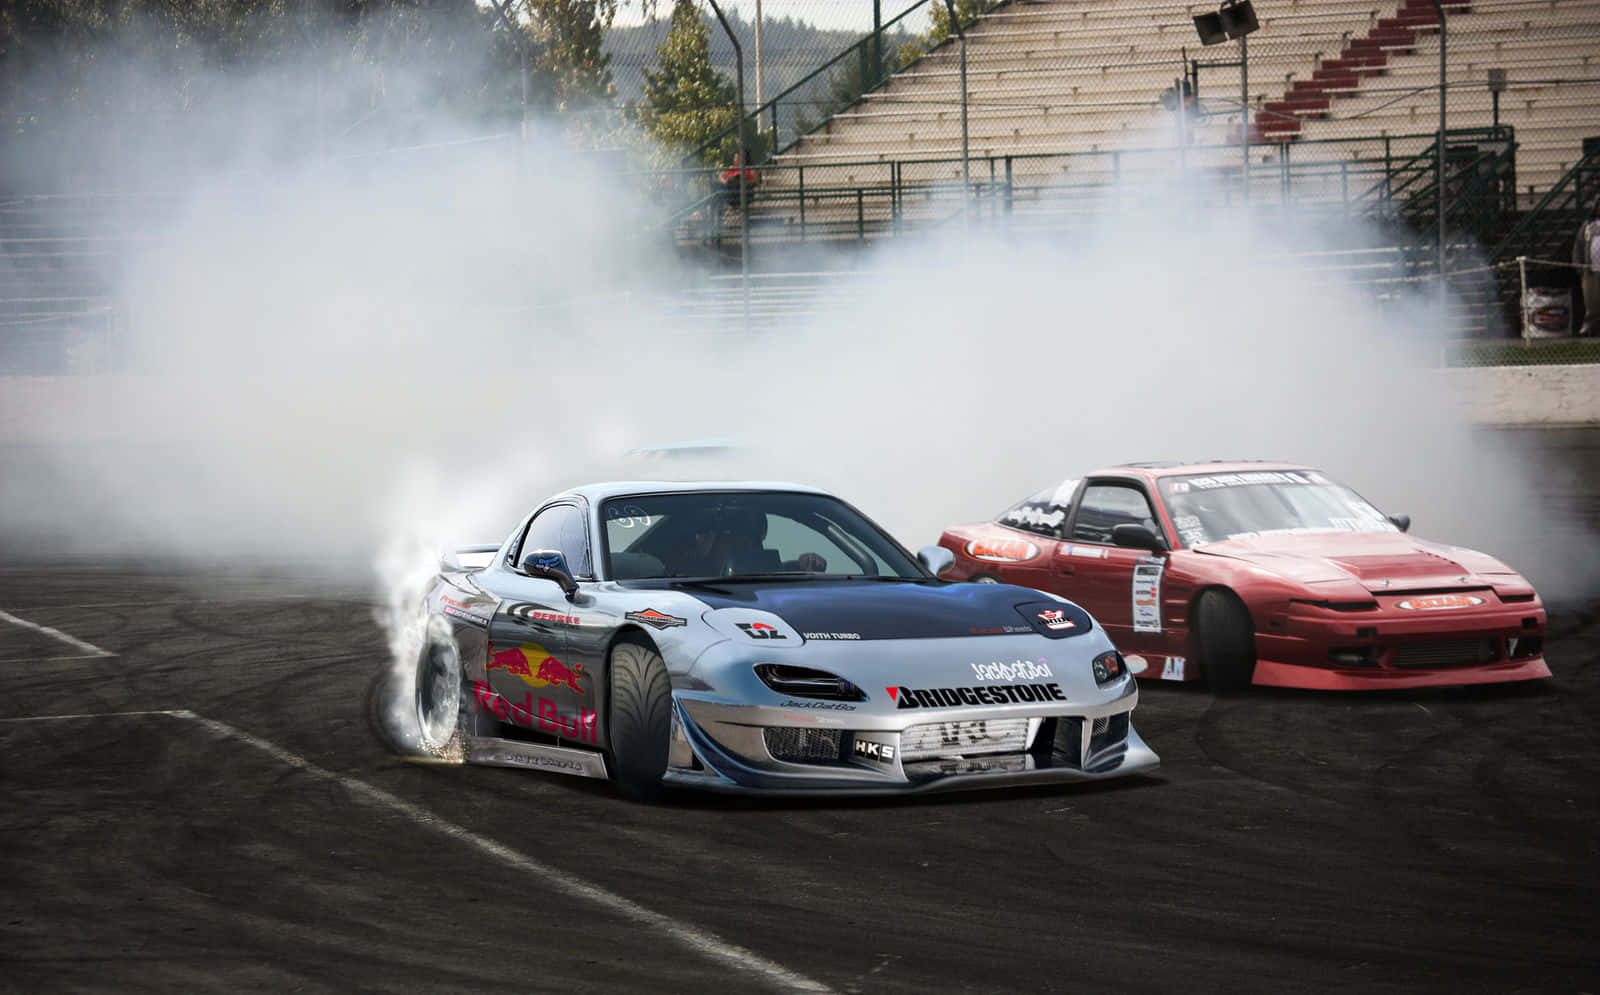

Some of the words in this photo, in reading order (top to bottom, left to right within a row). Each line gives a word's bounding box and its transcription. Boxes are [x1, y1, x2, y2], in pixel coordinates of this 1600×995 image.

[532, 611, 580, 624] PENSKE
[803, 632, 831, 640] VOITH
[831, 632, 860, 640] TURBO
[897, 683, 1067, 709] BRIDGESTONE
[473, 679, 533, 727] Red
[539, 697, 597, 744] Bull
[855, 739, 895, 759] HKS
